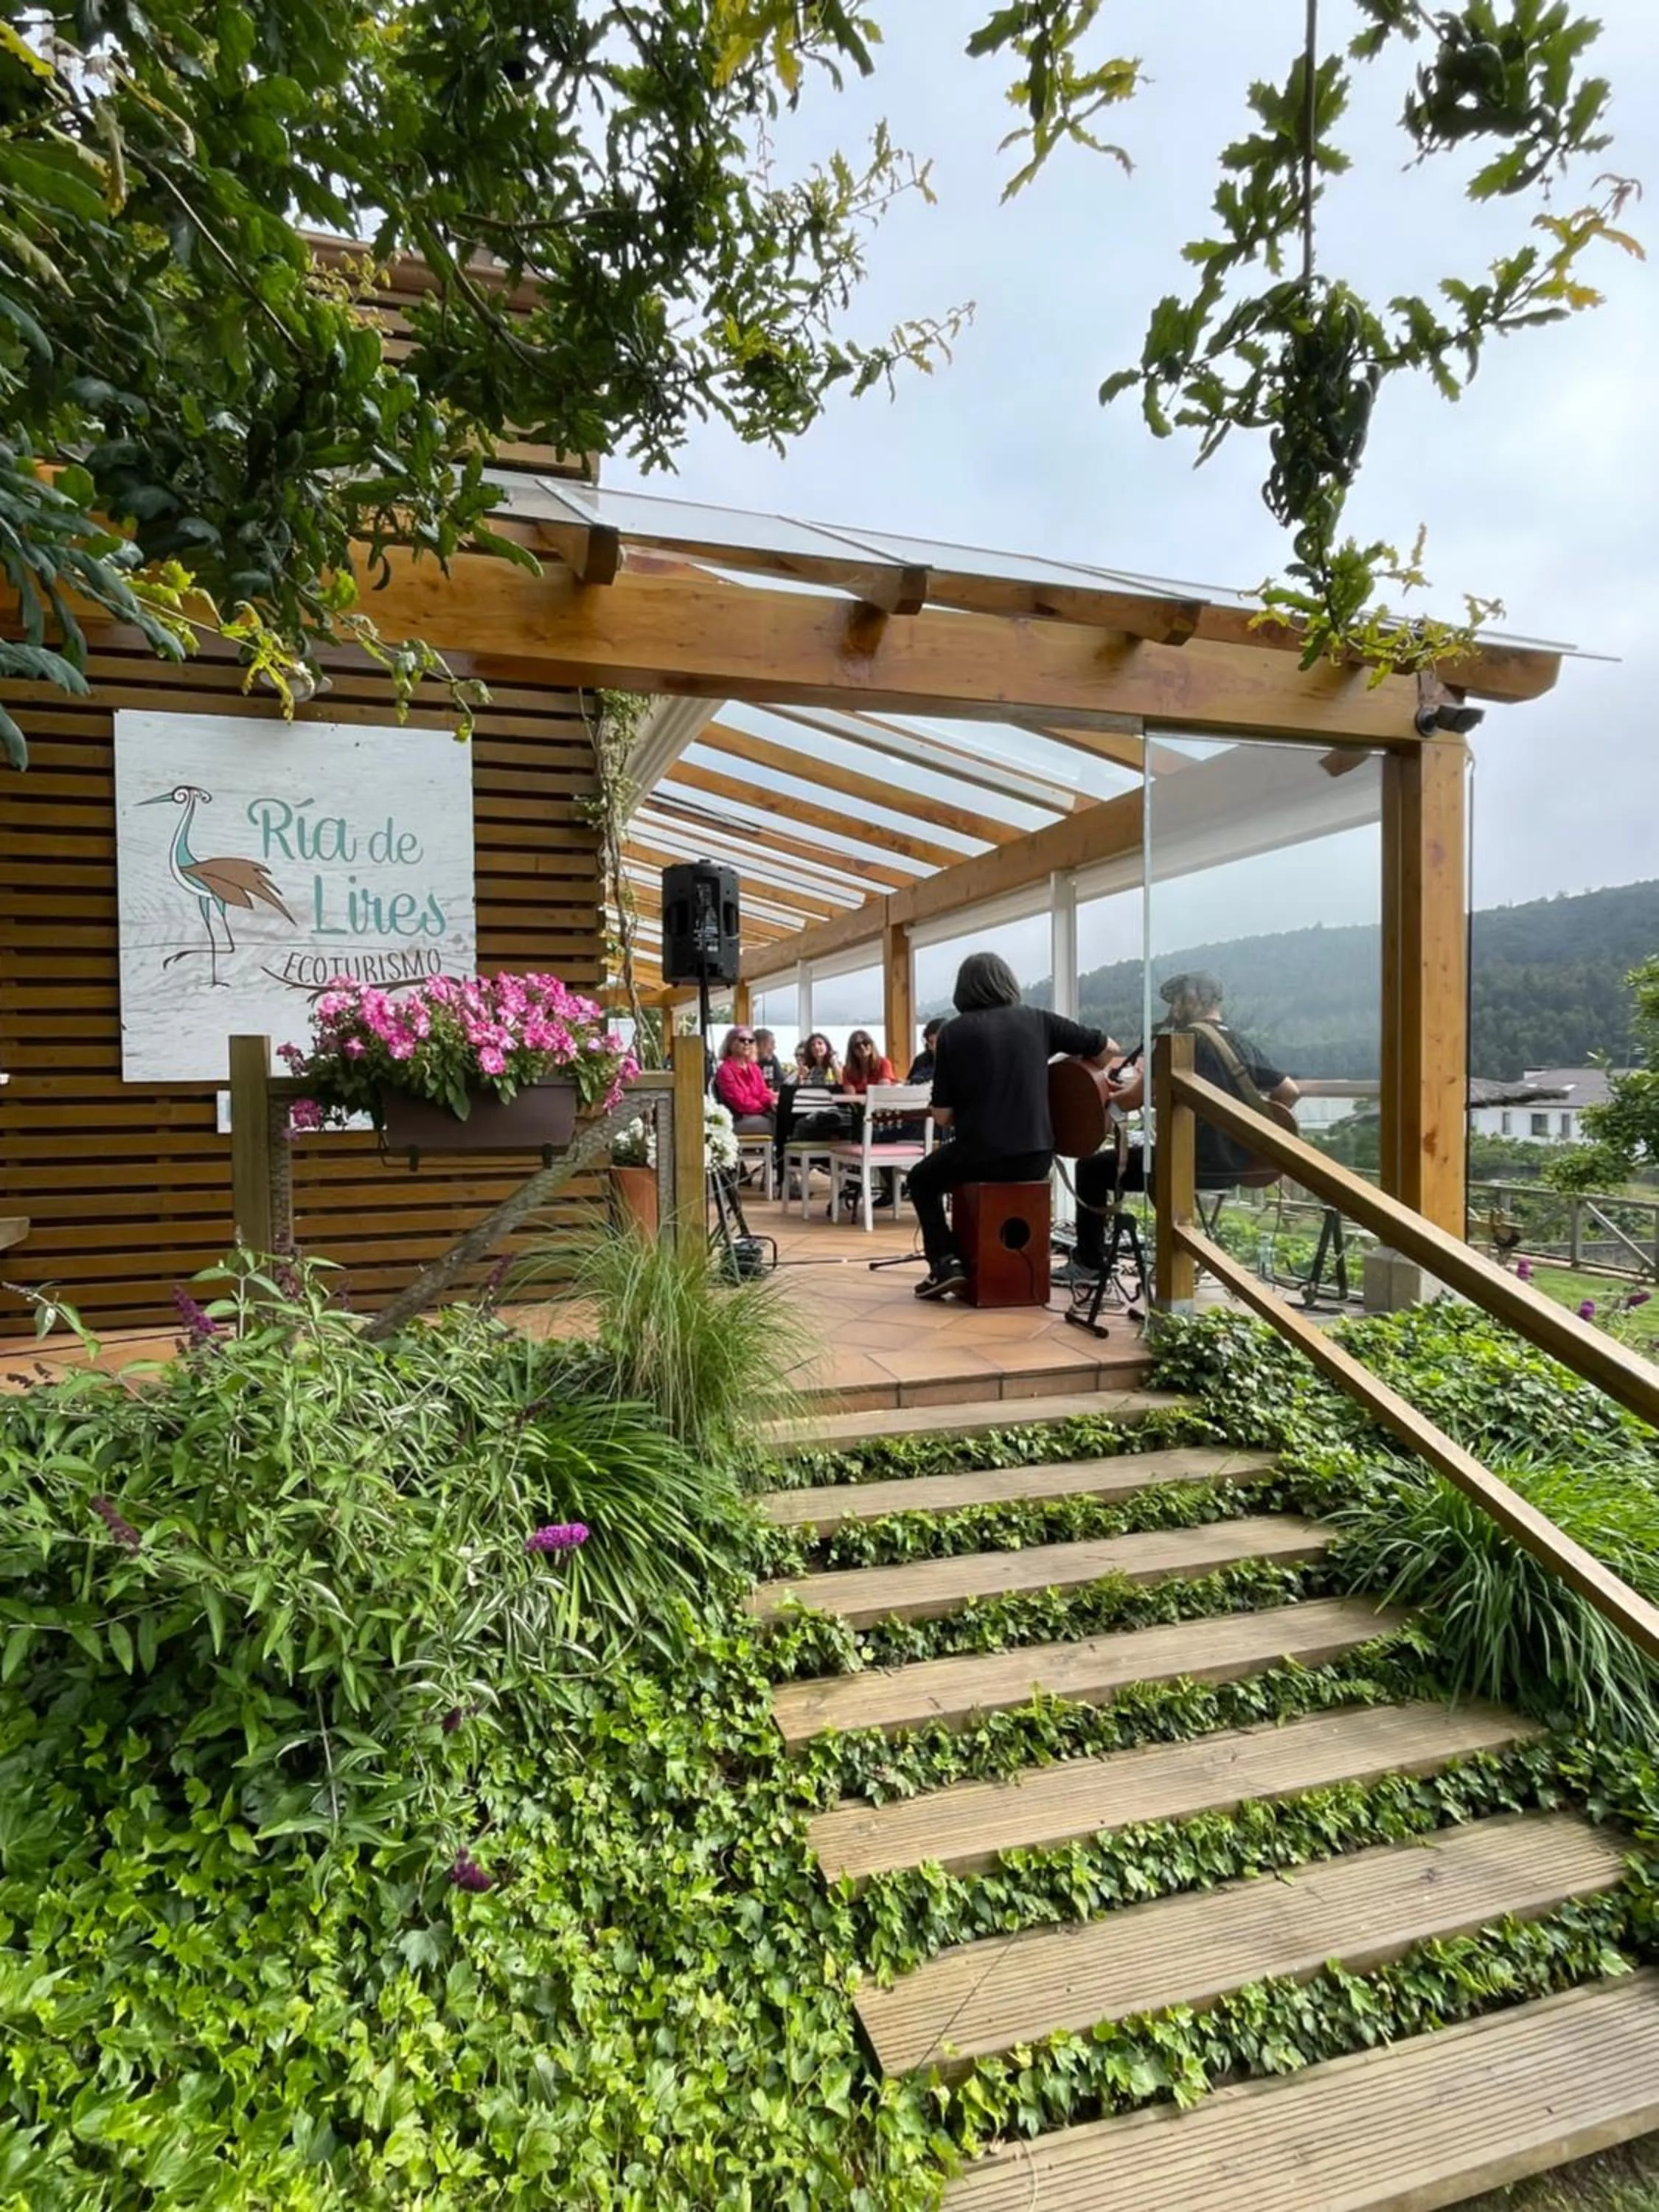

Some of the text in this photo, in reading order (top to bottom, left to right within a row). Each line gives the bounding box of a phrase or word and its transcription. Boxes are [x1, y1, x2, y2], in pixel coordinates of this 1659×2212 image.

[247, 797, 424, 865] Ría de
[310, 874, 447, 938] Lires
[283, 948, 442, 984] ECOTURISMO
